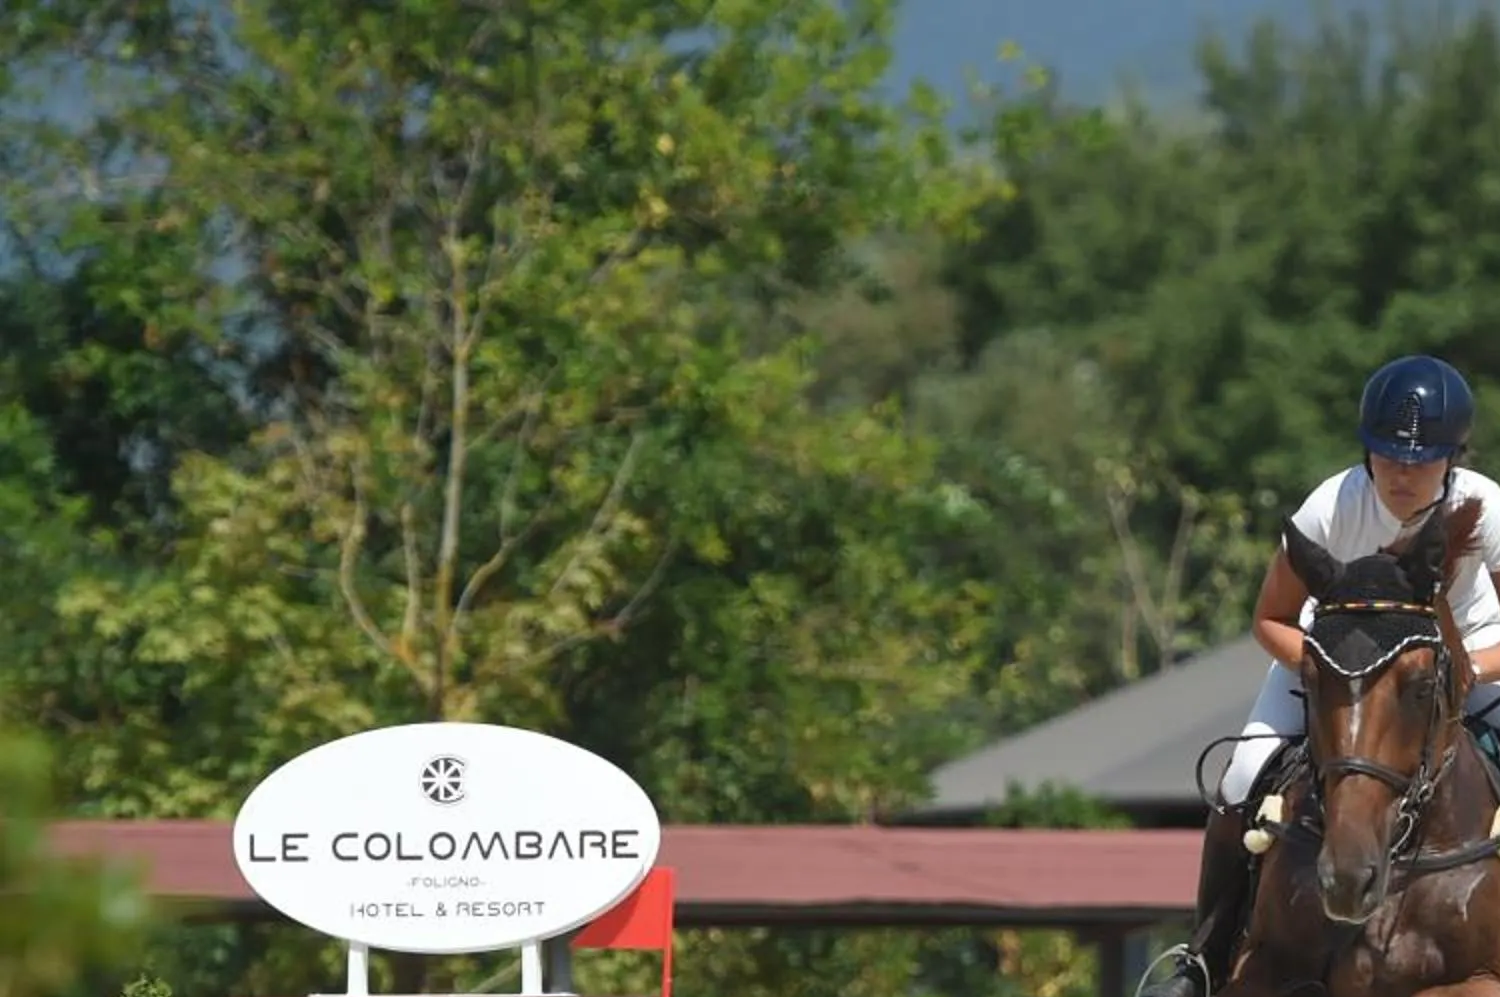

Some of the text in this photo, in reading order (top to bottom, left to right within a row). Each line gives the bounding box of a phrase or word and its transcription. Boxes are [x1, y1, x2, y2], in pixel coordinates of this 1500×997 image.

[249, 830, 640, 862] LE COLOMBARE
[350, 900, 546, 918] HOTEL & RESORT
